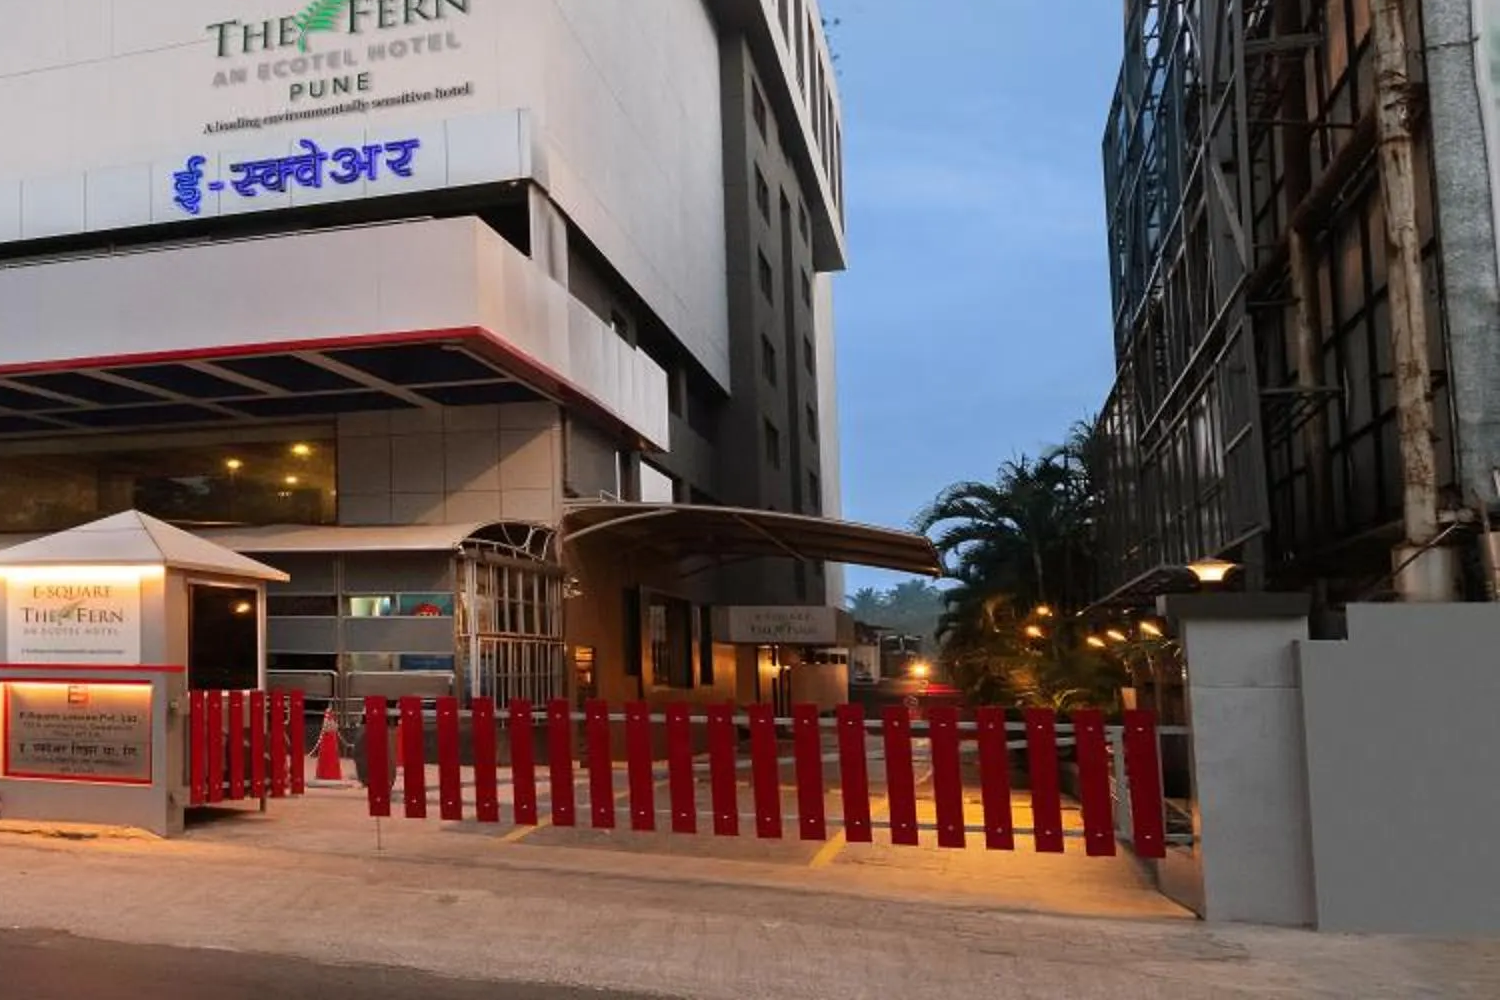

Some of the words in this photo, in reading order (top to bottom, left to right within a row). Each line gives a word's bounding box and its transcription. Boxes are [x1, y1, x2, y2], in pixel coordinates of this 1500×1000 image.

[206, 15, 299, 58] THE
[211, 67, 249, 89] AN
[257, 47, 359, 83] ECOTEL
[367, 31, 462, 63] HOTEL
[263, 99, 370, 127] environmentally
[435, 81, 474, 101] hotel
[289, 72, 373, 102] PUNE
[33, 585, 113, 600] E-SQUARE
[77, 606, 124, 623] FERN
